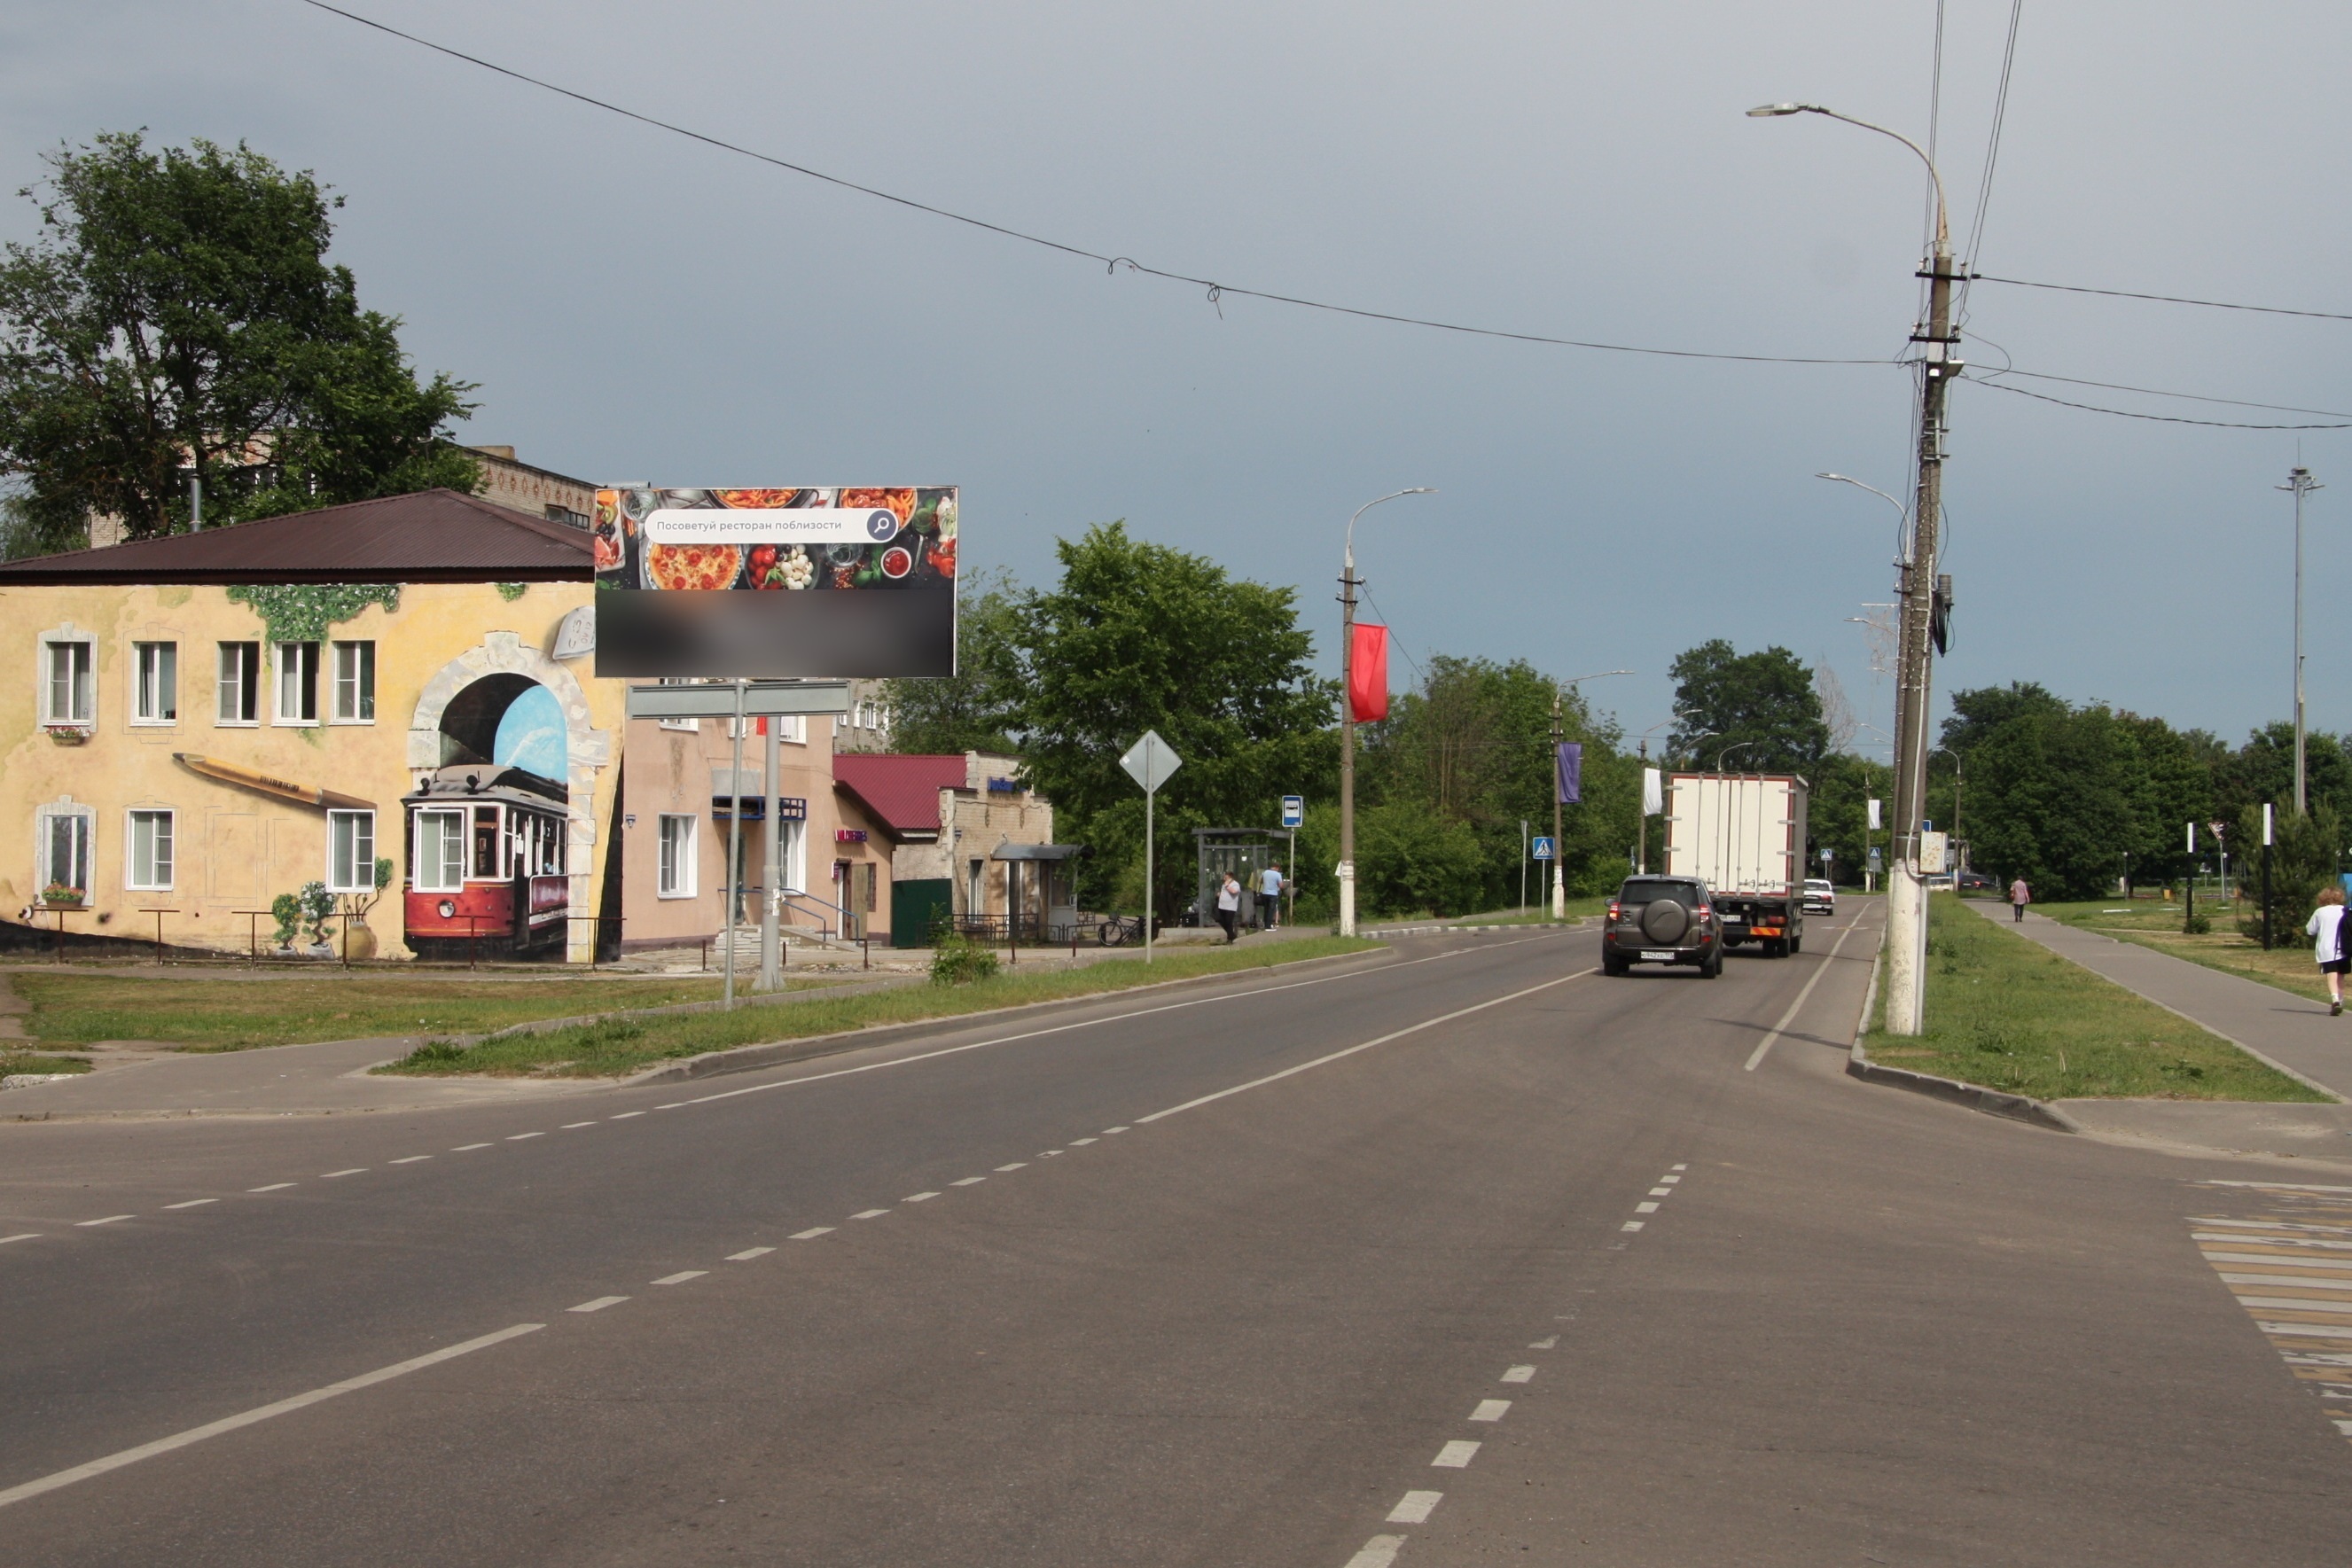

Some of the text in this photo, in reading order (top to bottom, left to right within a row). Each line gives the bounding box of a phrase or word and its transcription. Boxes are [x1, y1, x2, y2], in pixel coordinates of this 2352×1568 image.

[657, 520, 842, 532] Посоветуй ресторан поблизости
